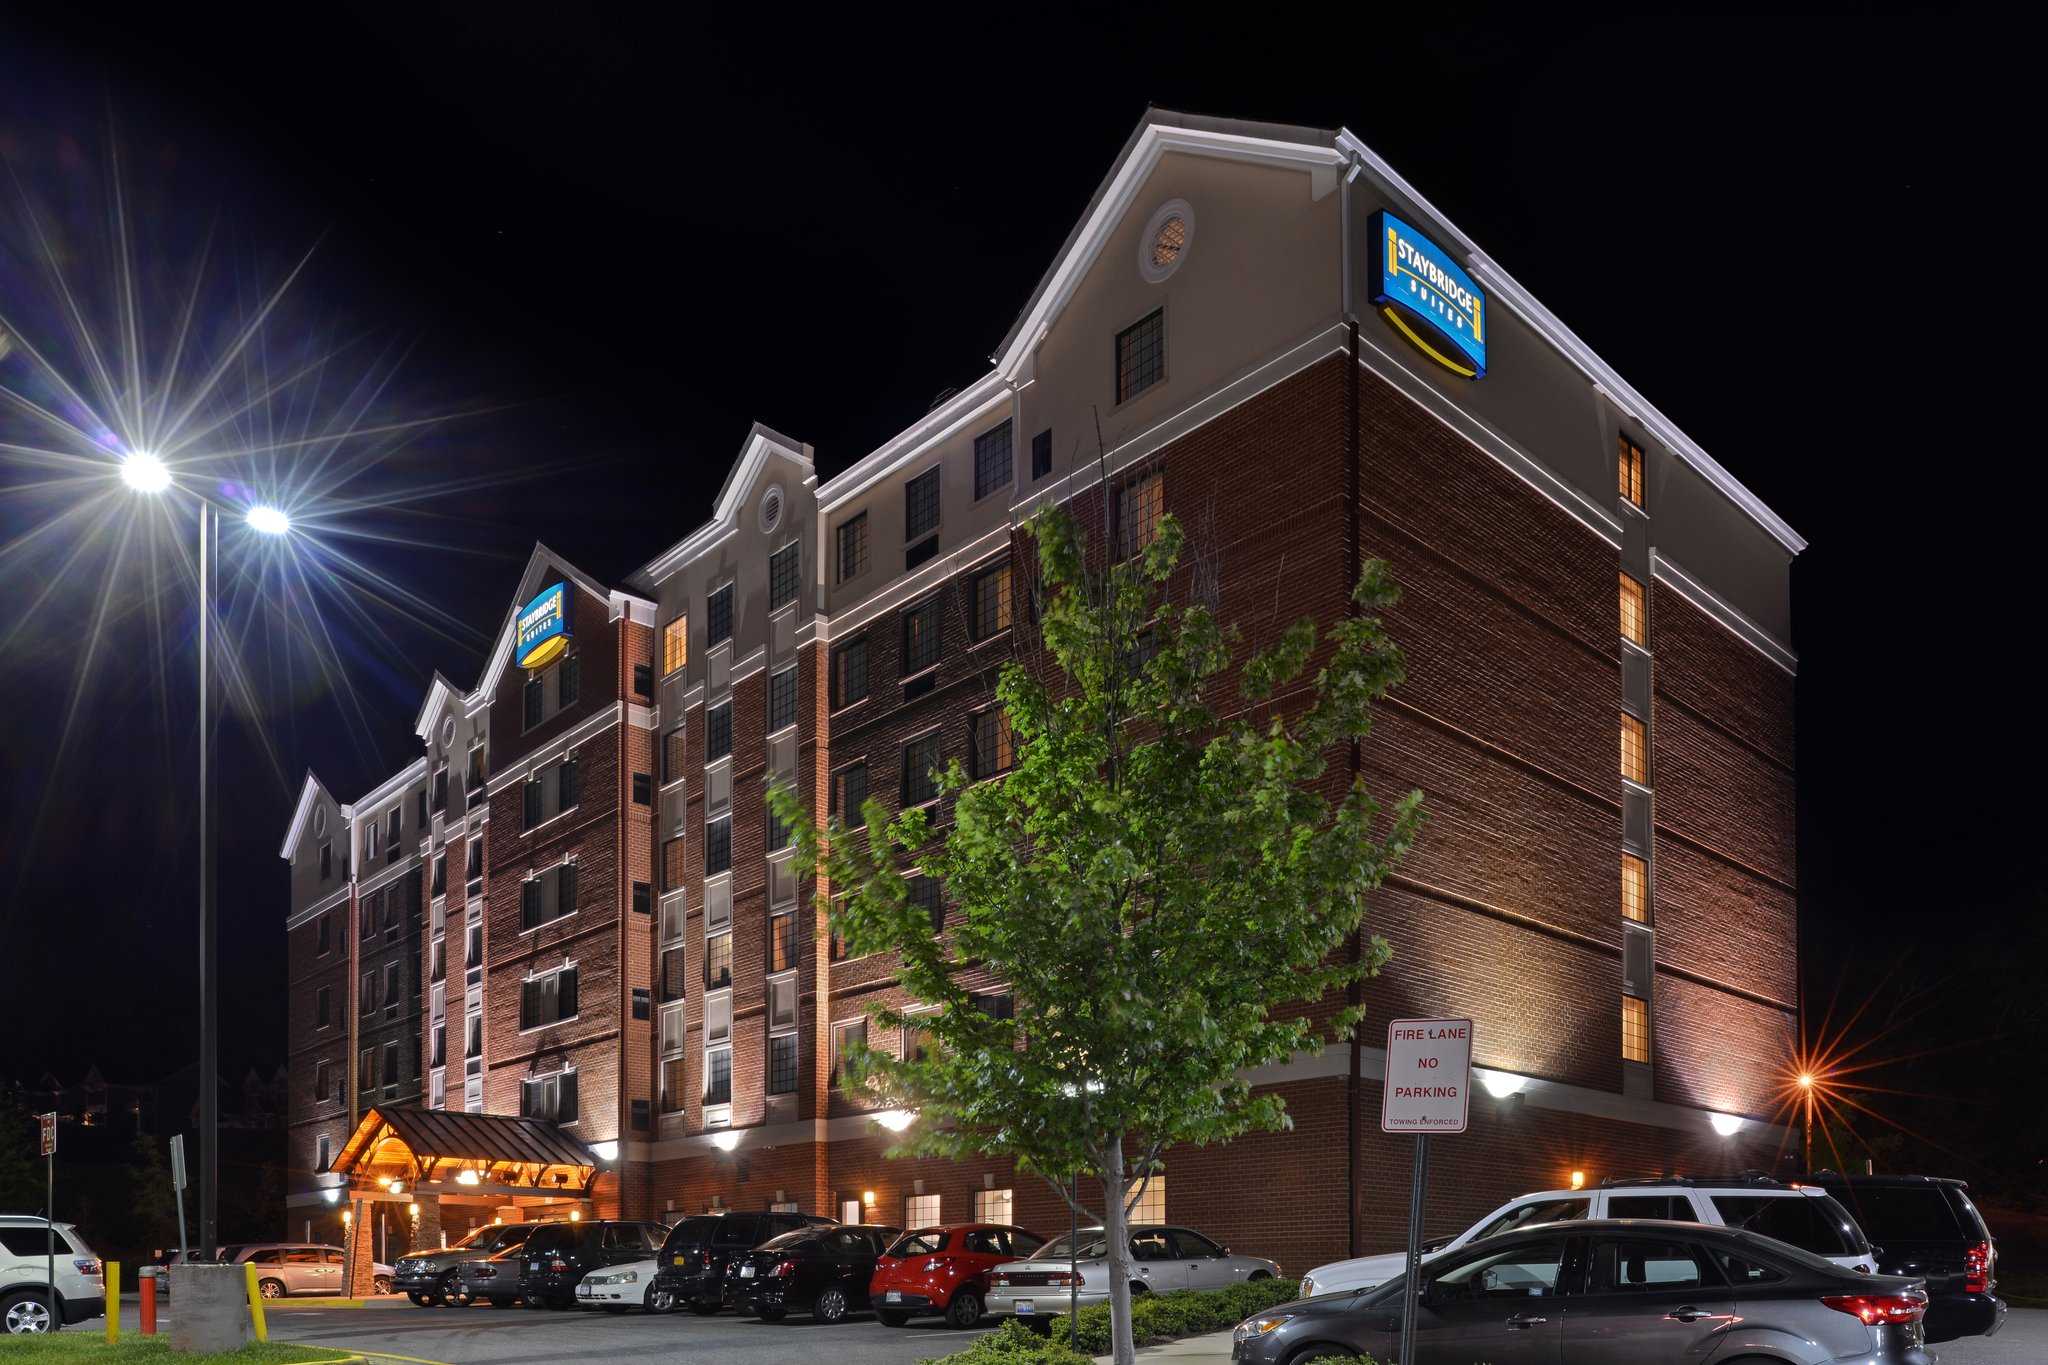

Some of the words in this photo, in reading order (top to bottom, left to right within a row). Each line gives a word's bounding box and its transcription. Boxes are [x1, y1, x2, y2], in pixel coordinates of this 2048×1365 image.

[1398, 238, 1473, 314] STAYBRIDGE
[1410, 279, 1463, 329] SUITES
[522, 595, 557, 631] STAYBRIDGE
[526, 619, 552, 642] SUITES
[1394, 1029, 1425, 1040] FIRE
[1428, 1028, 1467, 1040] LANE
[1418, 1057, 1439, 1069] NO
[1395, 1086, 1457, 1098] PARKING
[1389, 1118, 1418, 1126] TOWING
[1419, 1118, 1459, 1126] ENFORCED
